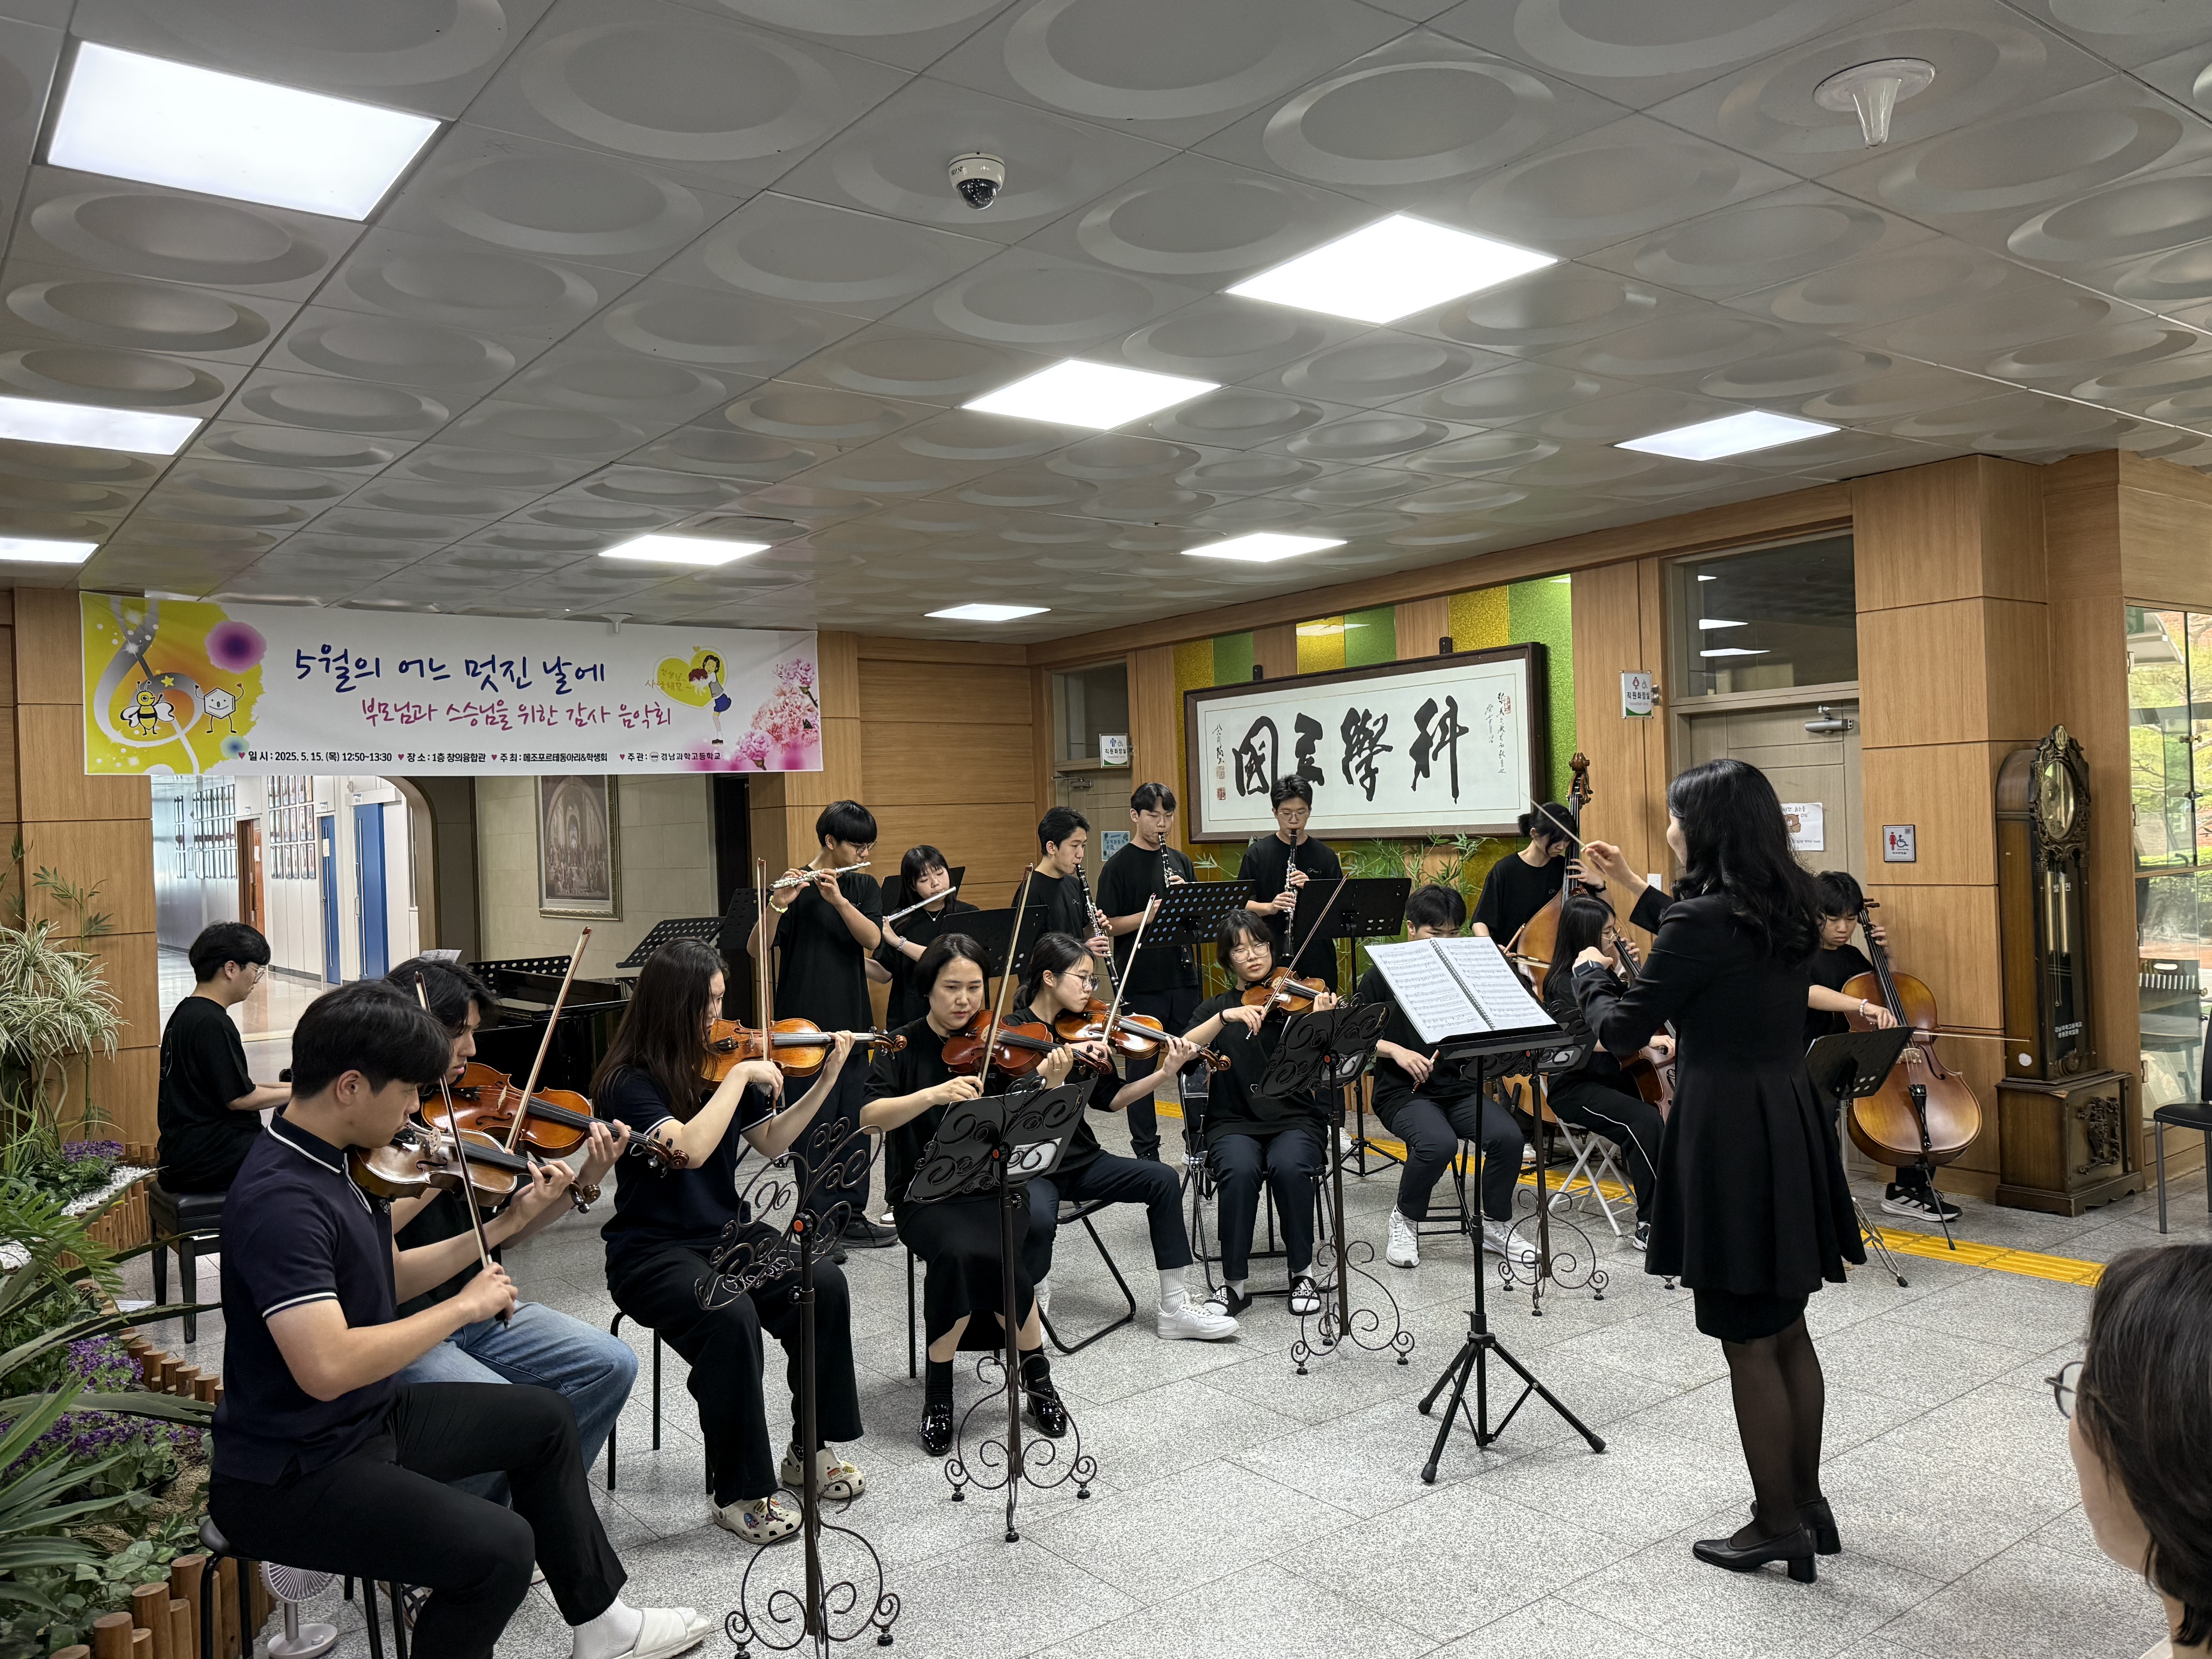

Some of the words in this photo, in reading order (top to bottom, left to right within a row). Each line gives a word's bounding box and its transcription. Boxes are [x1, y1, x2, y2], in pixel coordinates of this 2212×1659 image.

[296, 644, 380, 693] 5월의
[398, 657, 451, 681] 어느
[465, 654, 532, 692] 멋진
[543, 656, 605, 695] 날에
[1627, 691, 1650, 699] 직원화장실
[362, 697, 438, 727] 부모님과
[446, 699, 513, 731] 스승님을
[517, 703, 558, 726] 위한
[566, 702, 611, 727] 감사
[618, 701, 670, 729] 음악회
[275, 752, 299, 761] 2025.
[311, 752, 324, 761] 15.
[326, 752, 340, 762] (목)
[342, 752, 392, 762] 12:50~13:30
[432, 753, 445, 762] 1층
[447, 753, 486, 763] 창의융합관
[524, 753, 608, 763] 메조포르테동아리&학생회
[661, 752, 721, 761] 경남과학고등학교
